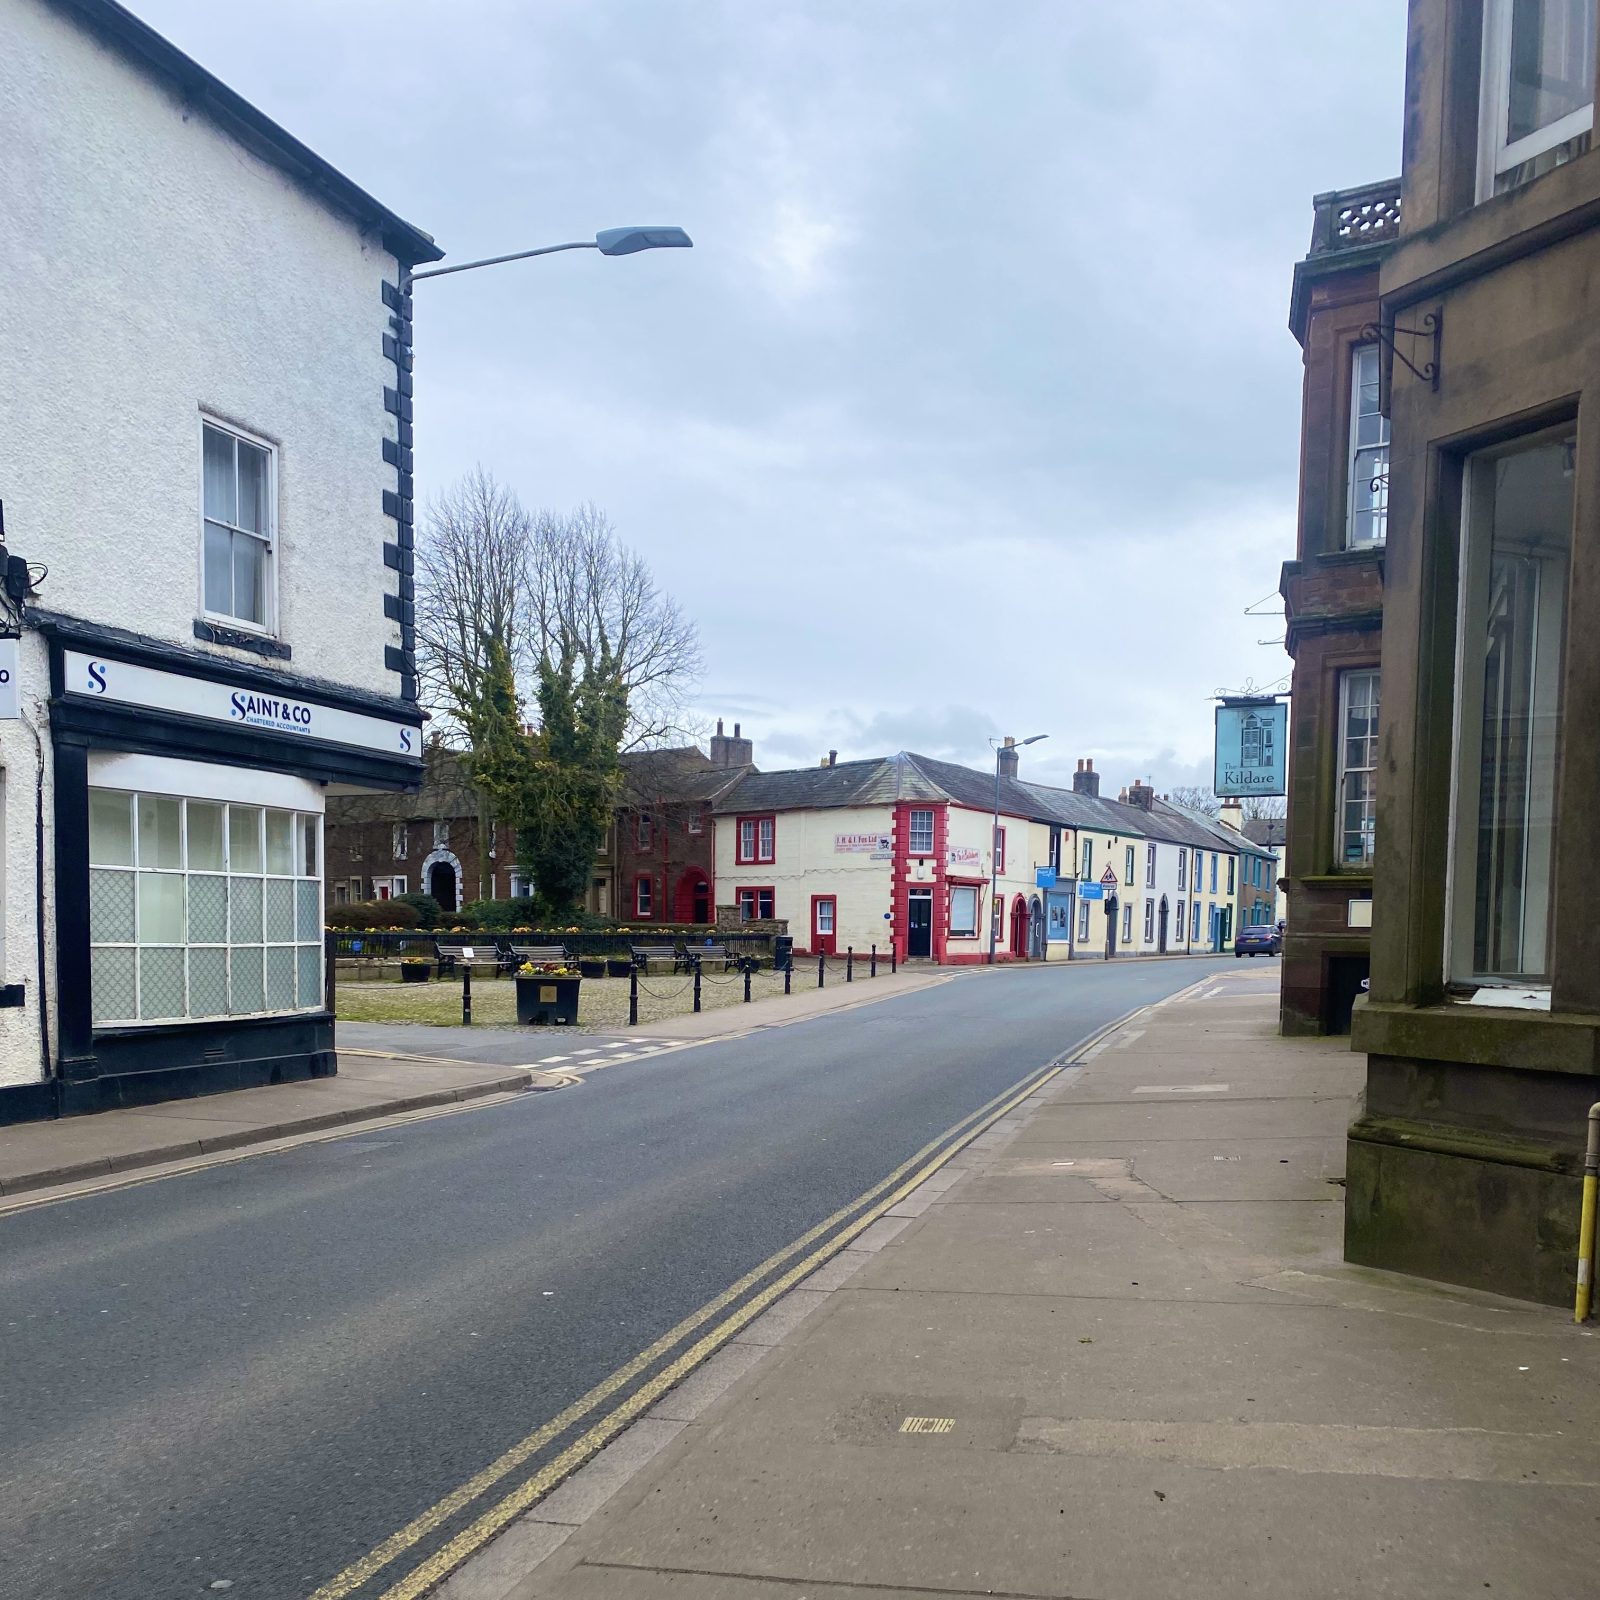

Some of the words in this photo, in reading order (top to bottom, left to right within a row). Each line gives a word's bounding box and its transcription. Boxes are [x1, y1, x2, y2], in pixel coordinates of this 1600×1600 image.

[246, 716, 275, 727] CHARTERED
[276, 722, 311, 734] ACCOUNTANTS
[1224, 771, 1275, 785] Kildare
